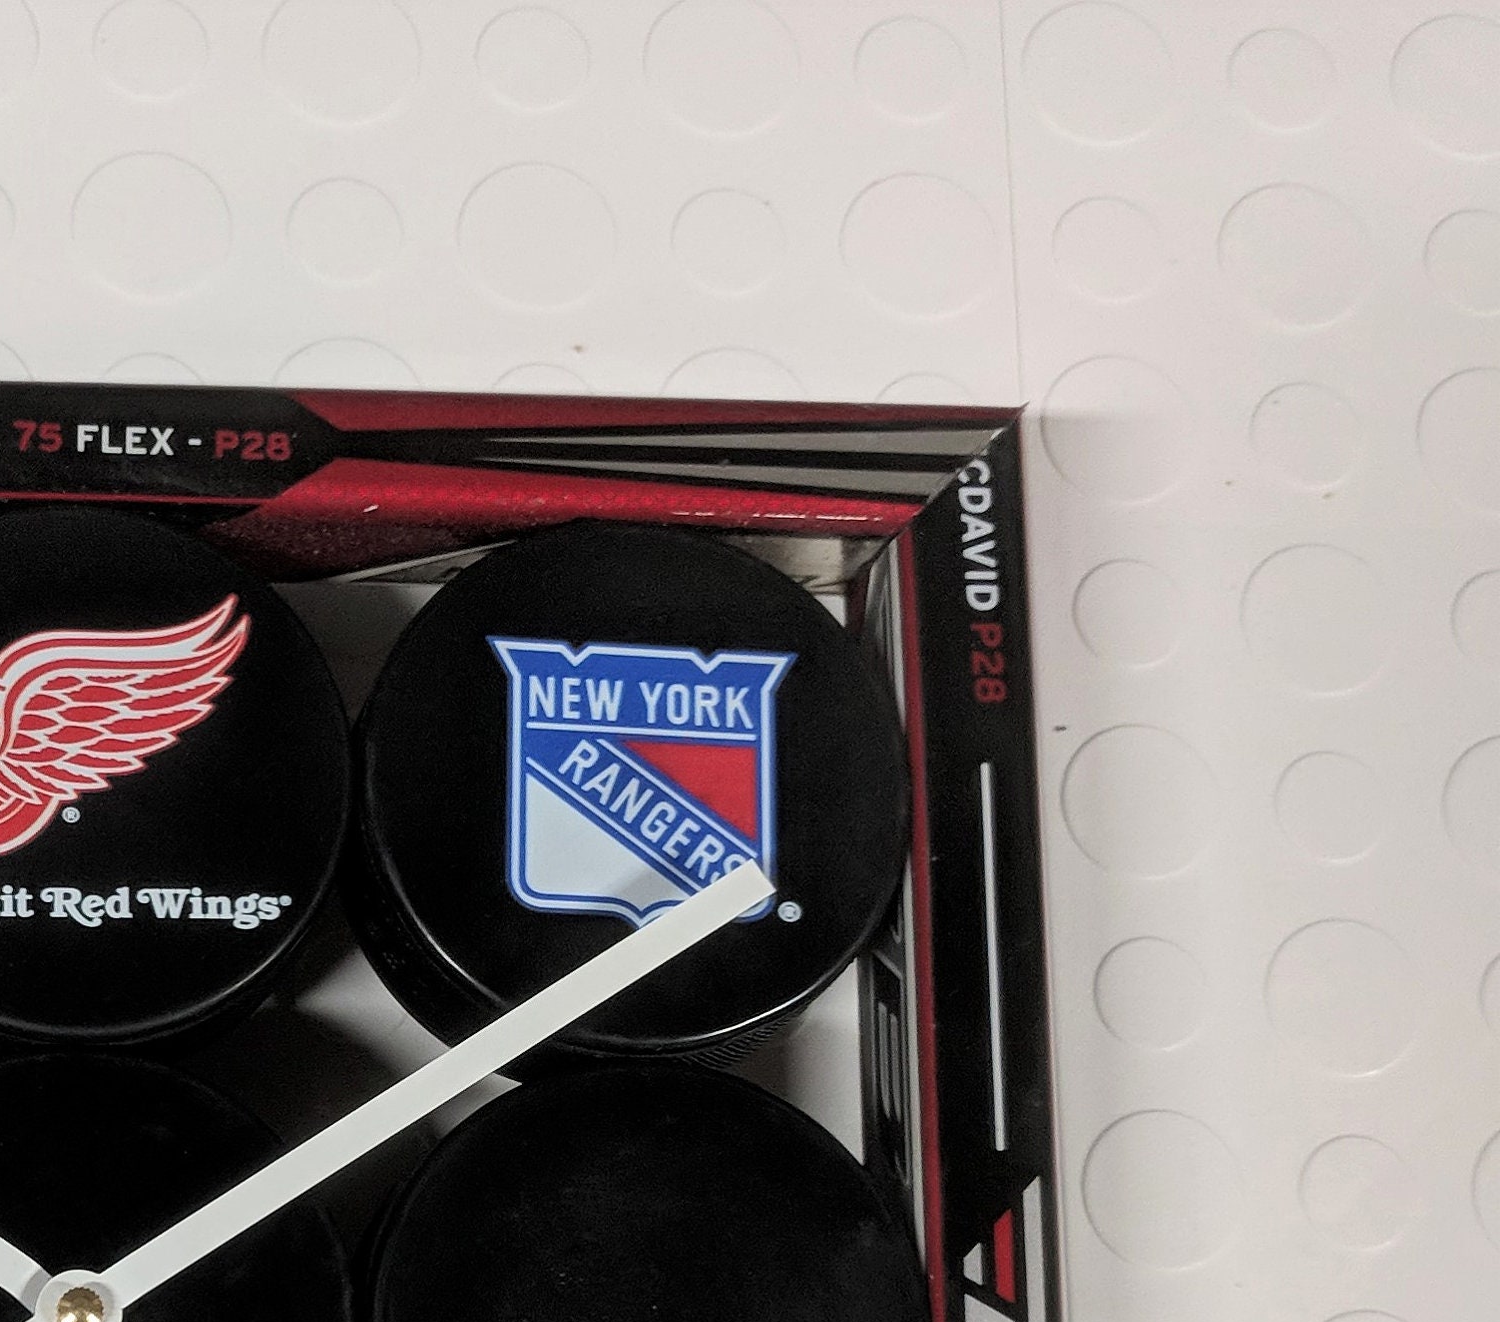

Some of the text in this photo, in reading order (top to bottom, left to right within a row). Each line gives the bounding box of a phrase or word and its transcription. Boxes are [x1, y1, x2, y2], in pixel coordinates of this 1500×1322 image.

[12, 419, 62, 453] 75
[75, 425, 174, 456] FLEX
[215, 430, 293, 461] P28
[970, 622, 1008, 704] P28
[528, 675, 753, 729] NEW YORK
[40, 886, 134, 928] Red
[136, 886, 282, 931] Wings
